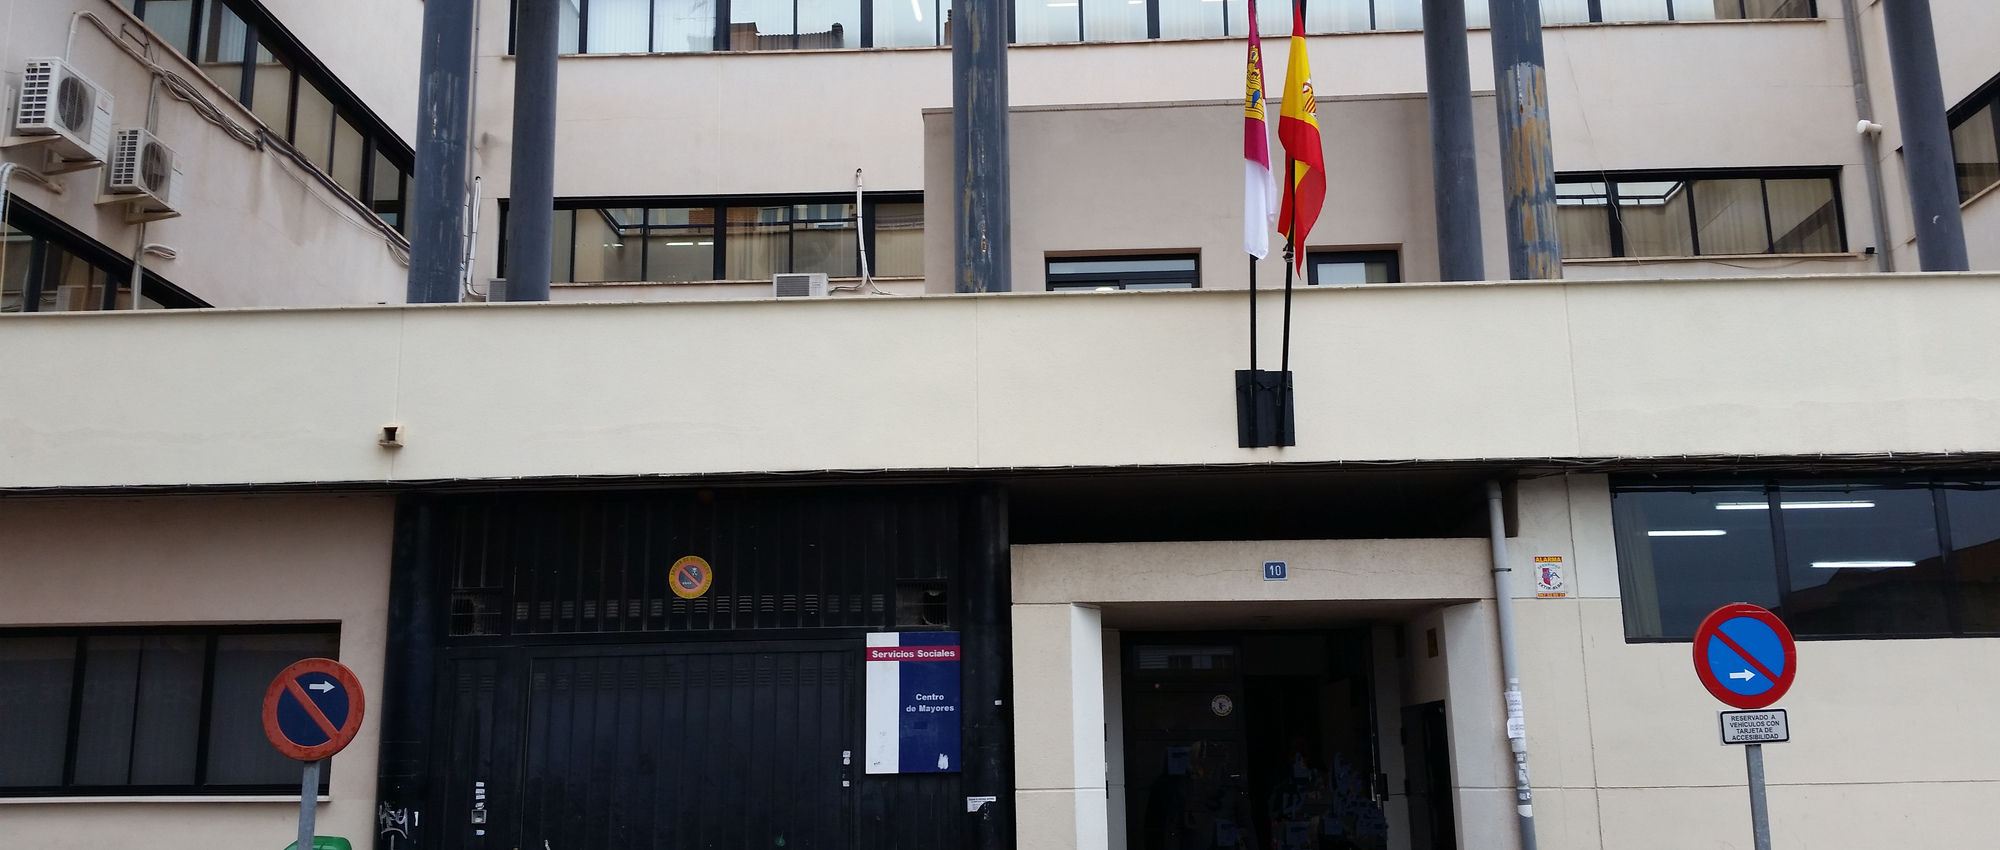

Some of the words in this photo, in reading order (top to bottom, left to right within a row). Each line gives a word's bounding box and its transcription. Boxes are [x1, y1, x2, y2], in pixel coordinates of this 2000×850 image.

[1270, 565, 1281, 576] 10
[872, 650, 914, 658] Servicios
[917, 650, 956, 658] Sociales
[918, 705, 954, 713] Mayores
